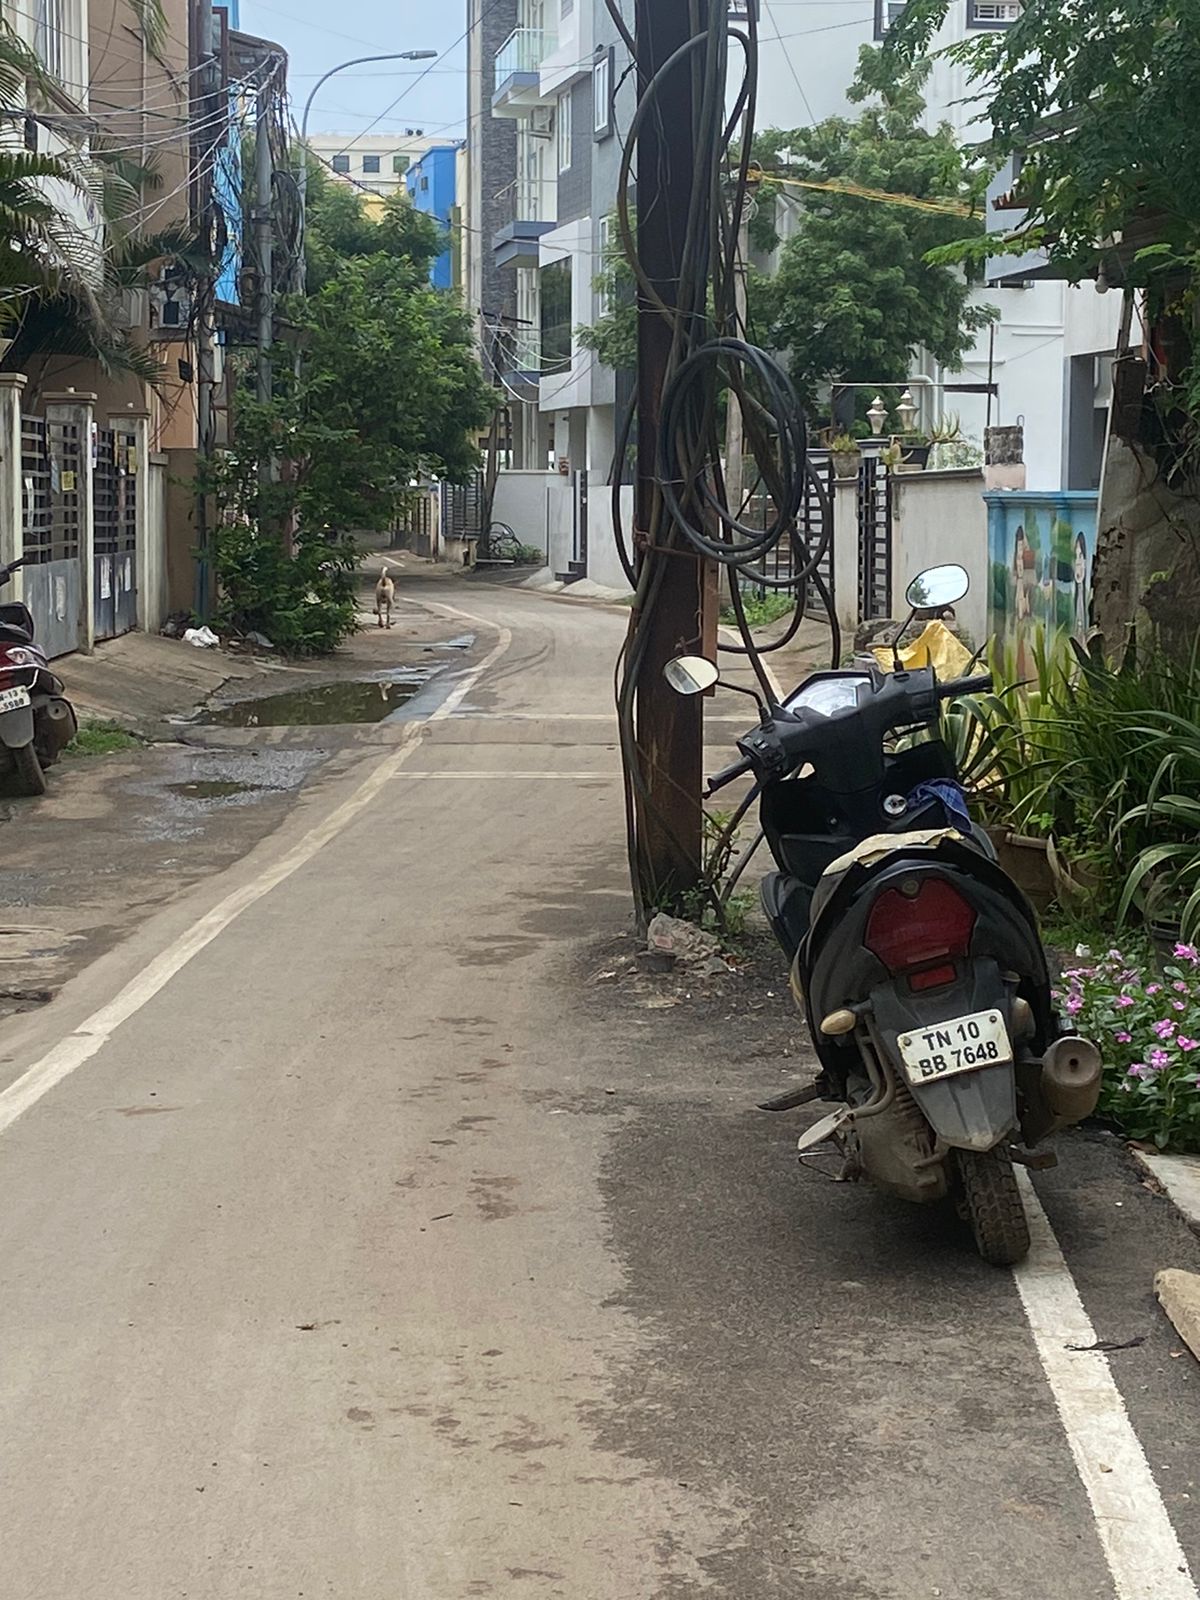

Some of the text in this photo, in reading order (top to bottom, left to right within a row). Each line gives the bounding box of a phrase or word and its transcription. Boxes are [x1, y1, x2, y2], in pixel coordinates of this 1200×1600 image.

[922, 1021, 980, 1051] TN 10
[919, 1041, 998, 1077] BB 7648
